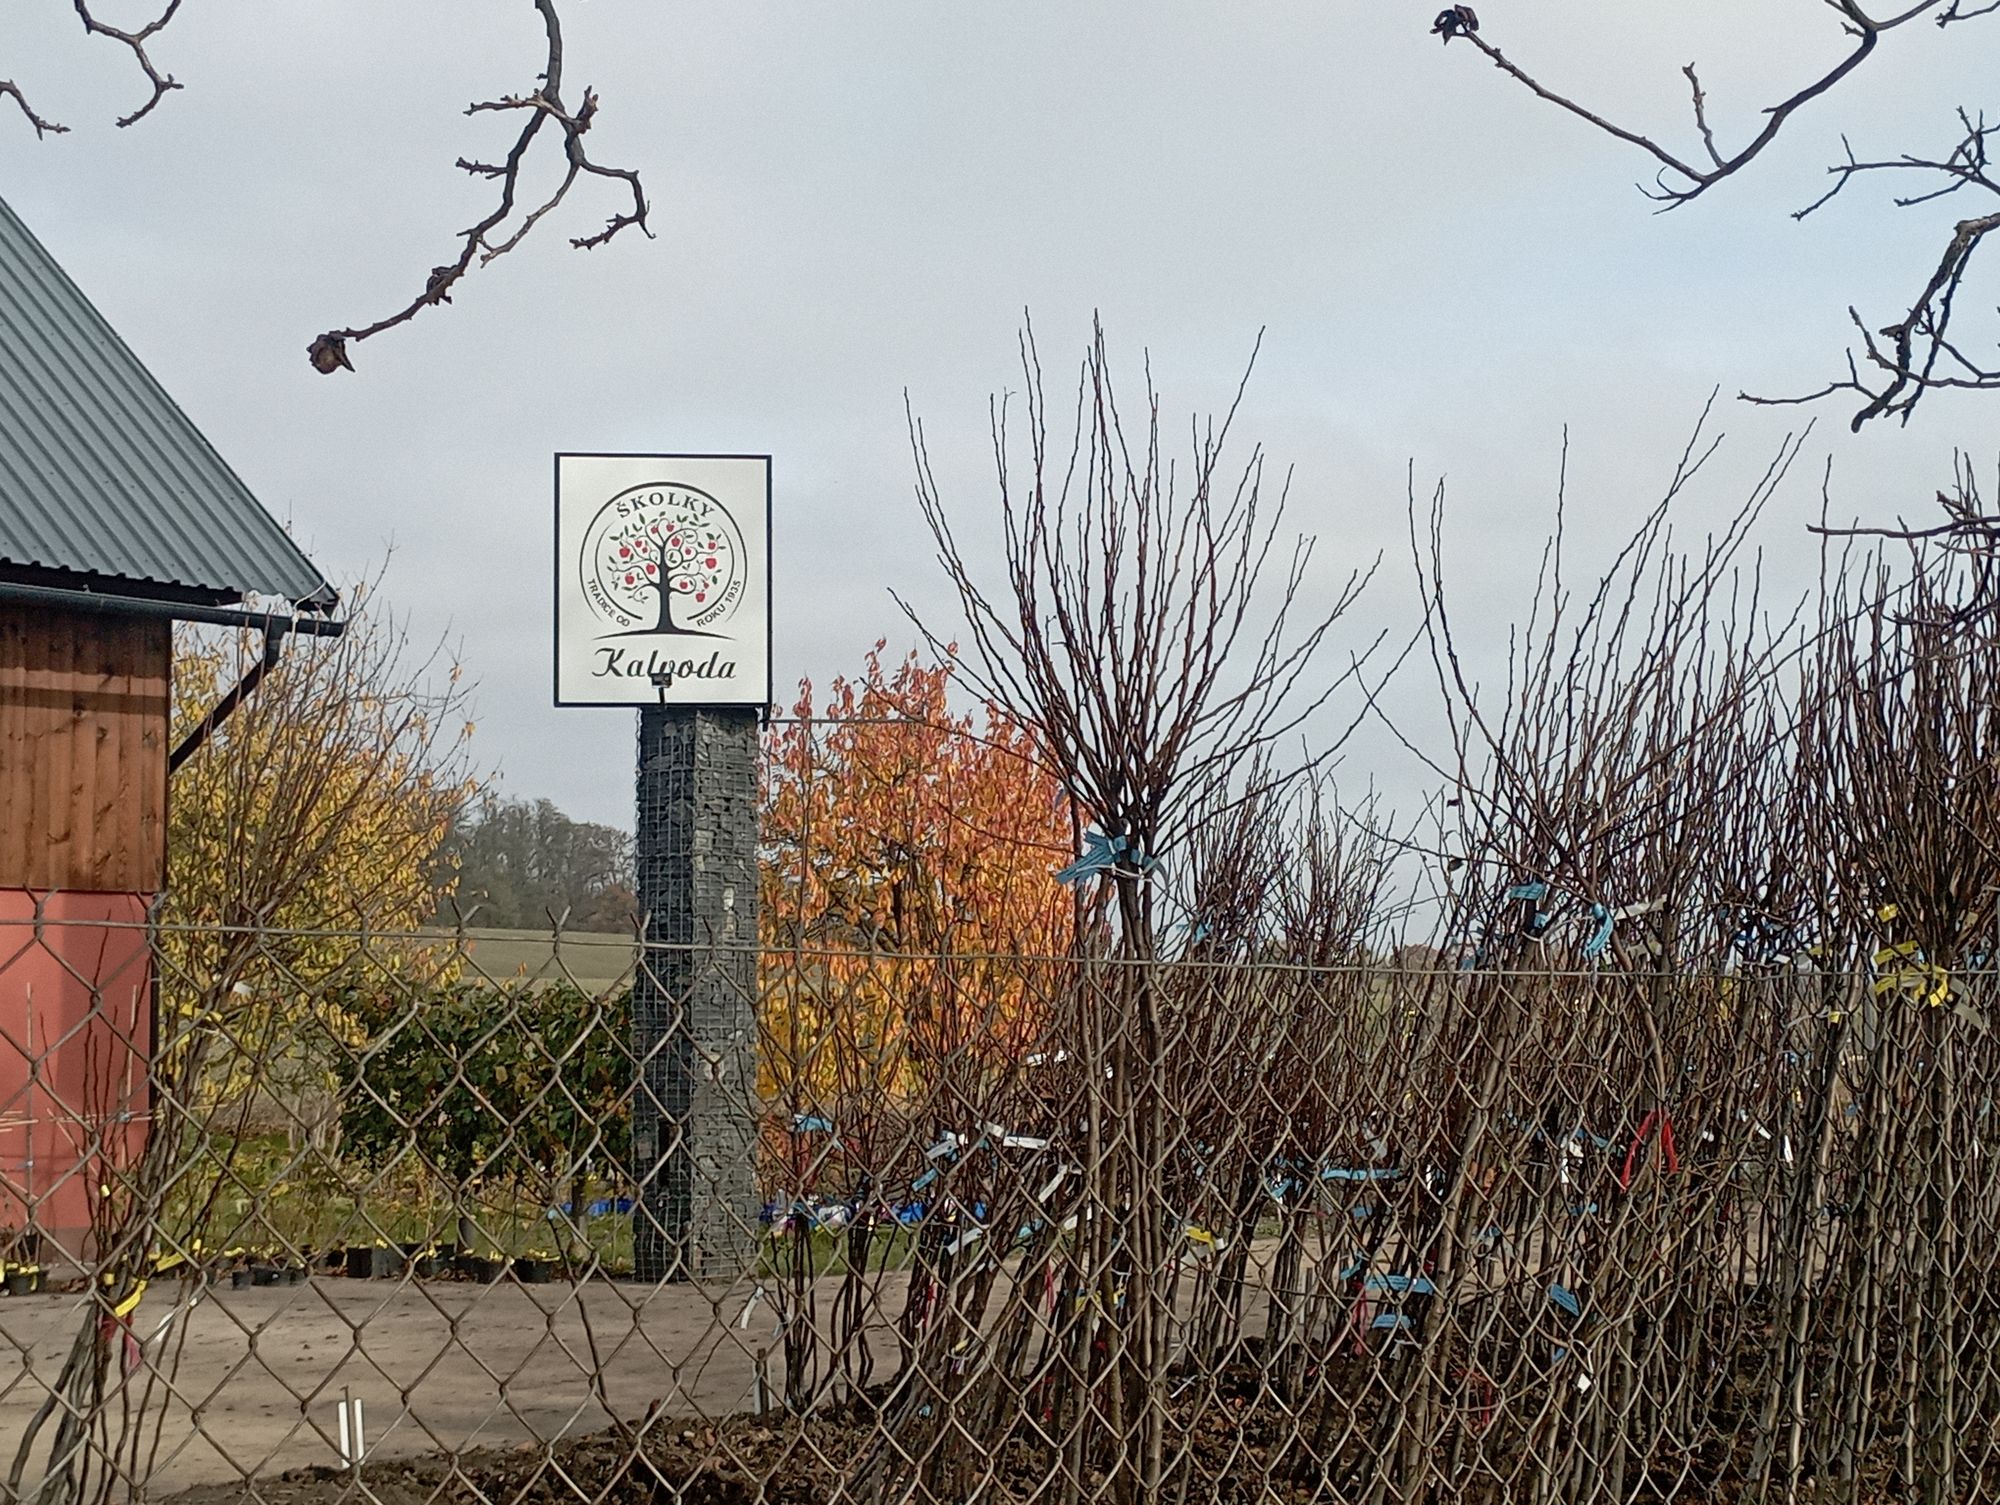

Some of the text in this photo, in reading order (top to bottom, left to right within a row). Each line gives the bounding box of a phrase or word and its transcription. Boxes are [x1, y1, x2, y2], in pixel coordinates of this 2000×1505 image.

[616, 492, 715, 518] ŠKOLKY
[588, 578, 616, 618] TRADICE
[696, 603, 726, 627] ROKU
[725, 580, 741, 603] 1935
[592, 647, 736, 679] Kalvoda
